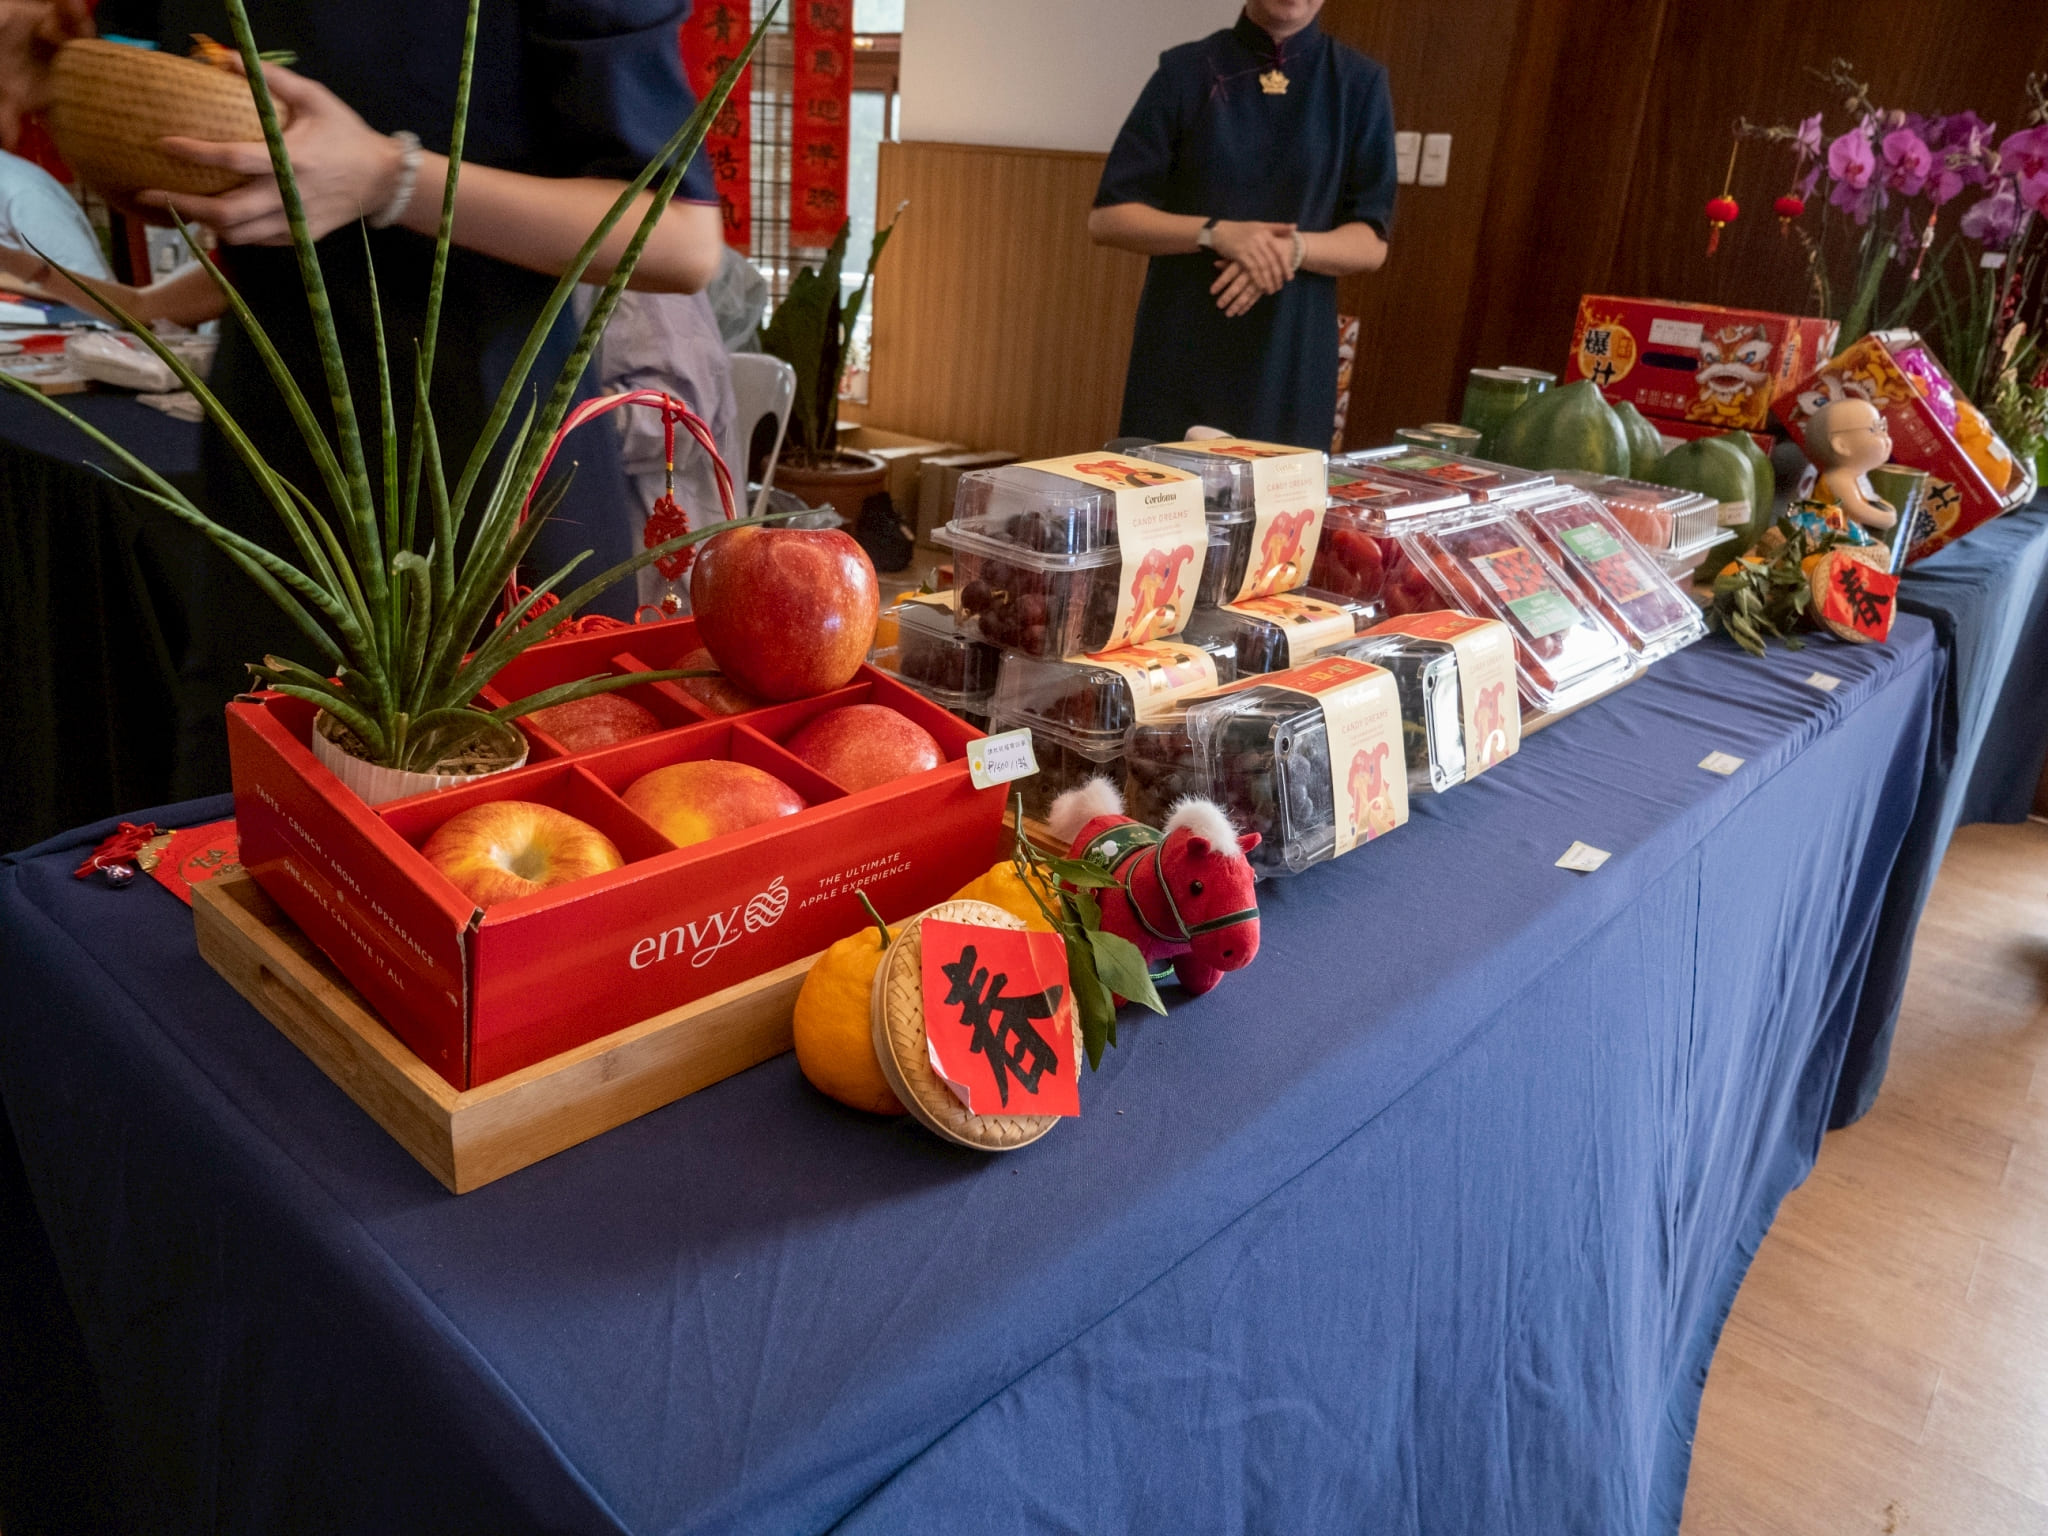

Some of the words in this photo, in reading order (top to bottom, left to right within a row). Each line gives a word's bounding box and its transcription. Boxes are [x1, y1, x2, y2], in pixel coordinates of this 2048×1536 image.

[1584, 329, 1616, 386] 爆汁
[1132, 515, 1157, 528] CANDY
[1158, 510, 1189, 523] DREAMS
[1838, 567, 1890, 628] 春
[1341, 719, 1364, 735] CANDY
[1364, 710, 1389, 728] DREAMS
[255, 784, 280, 813] TASTE
[288, 816, 322, 855] CRUNCH
[330, 859, 361, 895] AROMA
[371, 900, 434, 968] APPEARANCE
[799, 887, 837, 909] APPLE
[841, 861, 912, 894] EXPERIENCE
[818, 873, 841, 888] THE
[845, 851, 901, 879] ULTIMATE
[284, 860, 301, 881] ONE
[303, 880, 329, 911] APPLE
[330, 908, 348, 931] CAN
[350, 929, 373, 958] HAVE
[376, 954, 384, 969] IT
[387, 967, 405, 991] ALL
[629, 904, 743, 970] envy
[941, 944, 1064, 1109] 春
